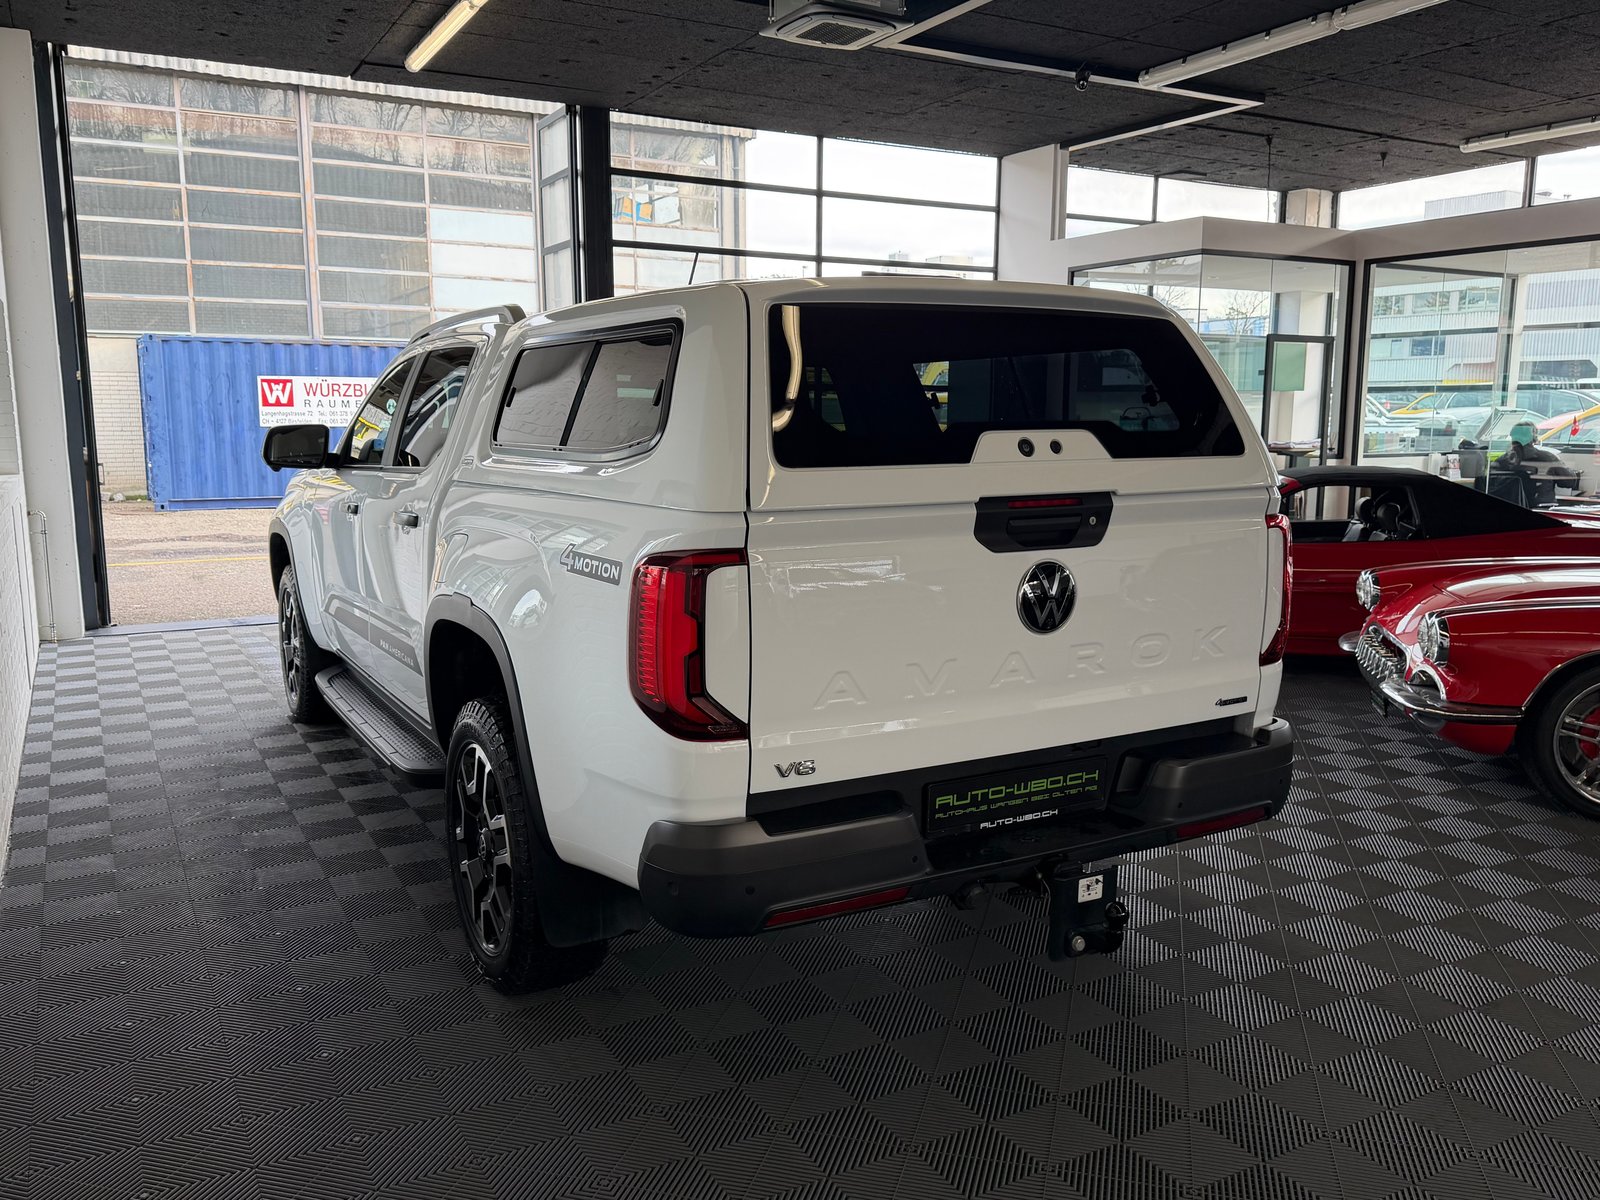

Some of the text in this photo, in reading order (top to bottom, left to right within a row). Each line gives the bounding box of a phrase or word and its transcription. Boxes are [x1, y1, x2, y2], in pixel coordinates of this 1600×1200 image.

[560, 543, 620, 580] 4MOTION
[813, 624, 1229, 711] AMAROK
[773, 759, 816, 778] V6
